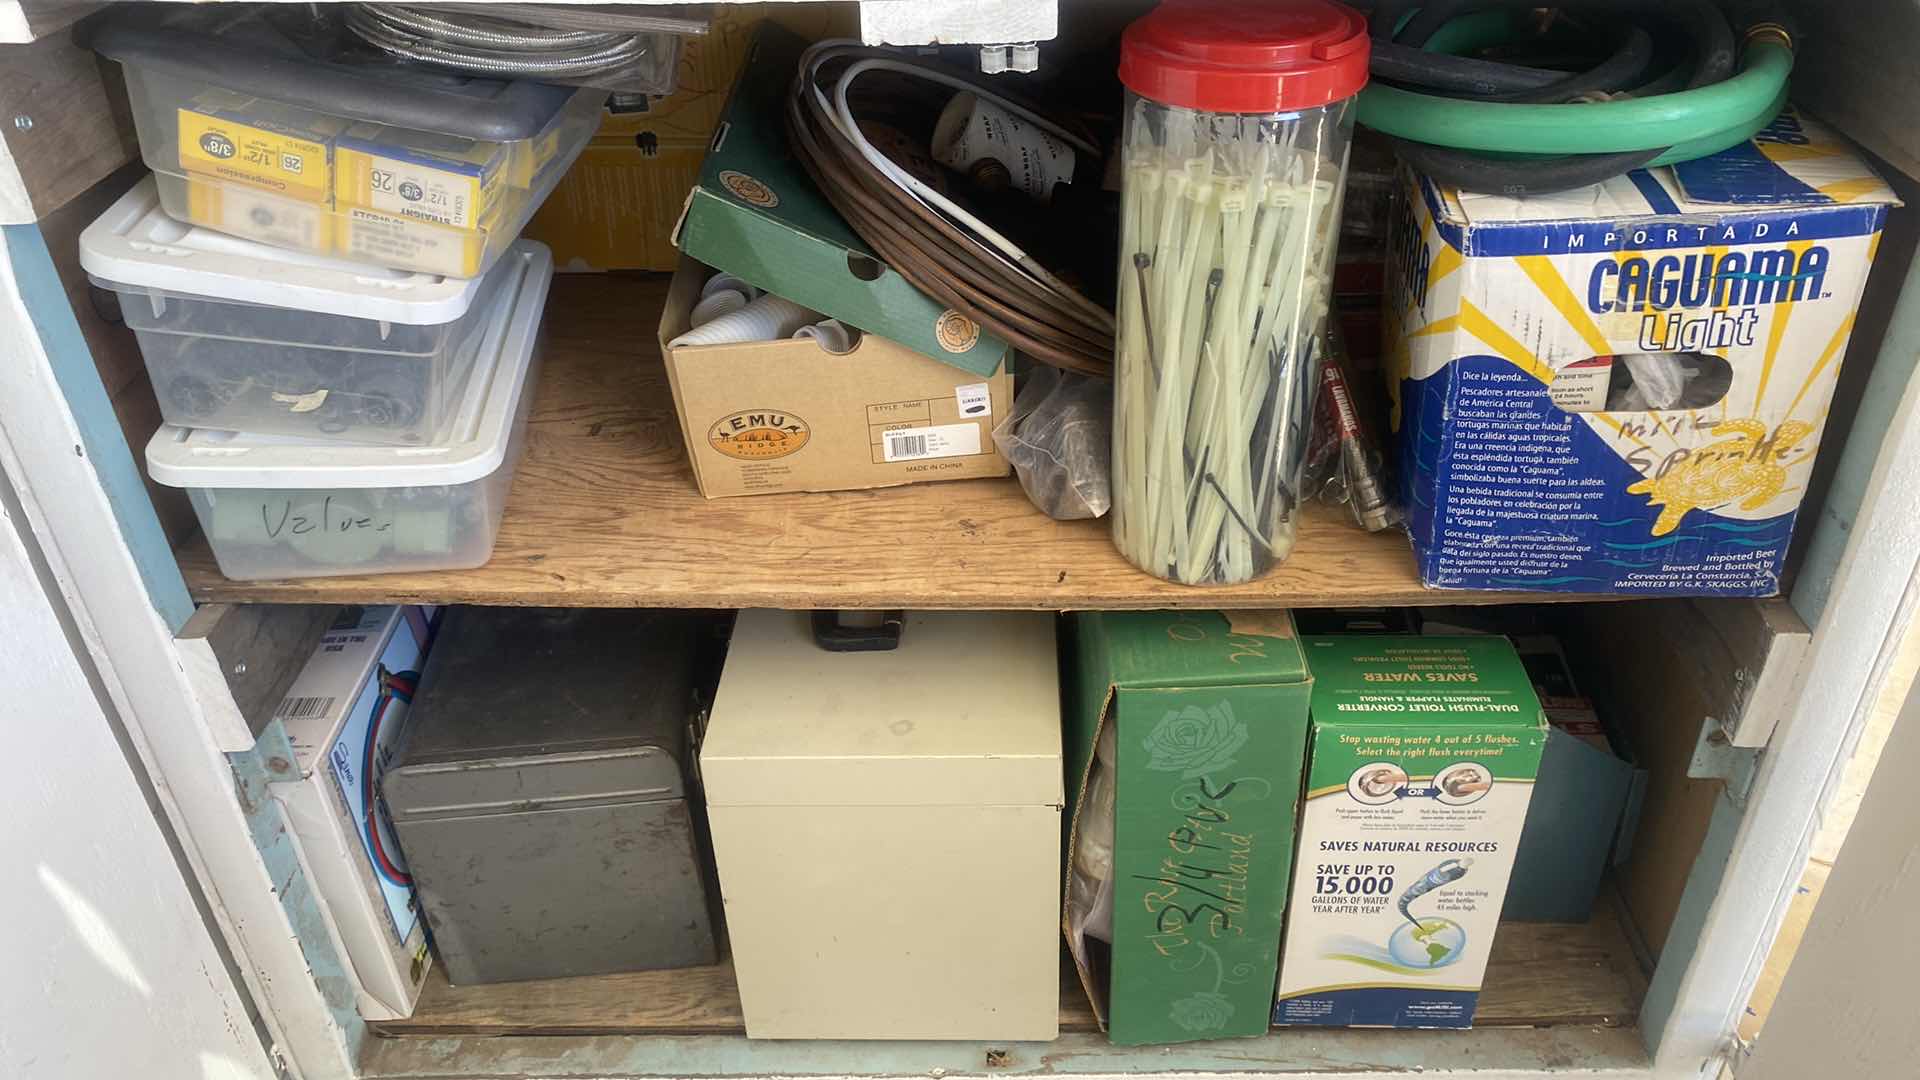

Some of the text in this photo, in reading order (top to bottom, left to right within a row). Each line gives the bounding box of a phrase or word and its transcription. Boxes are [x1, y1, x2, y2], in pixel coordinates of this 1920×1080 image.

[204, 140, 232, 156] 3/8"
[284, 156, 300, 170] 26
[216, 166, 286, 191] Compression
[371, 171, 392, 191] 26
[1588, 246, 1830, 315] CAGUAMA
[1638, 308, 1759, 353] Light
[1463, 371, 1480, 380] Dice
[1482, 372, 1489, 380] la
[1461, 387, 1504, 397] Pescadores
[1460, 398, 1533, 408] de América Central
[1459, 410, 1495, 418] buscaban
[1510, 412, 1540, 422] grandes
[730, 415, 785, 430] EMU
[1457, 420, 1540, 432] tortugas marinas que
[1467, 431, 1478, 439] las
[1480, 432, 1506, 441] cálidas
[1508, 435, 1530, 443] aguas
[1455, 442, 1466, 450] Era
[1556, 447, 1571, 455] que
[1452, 462, 1485, 472] conocida
[1510, 464, 1517, 473] la
[1450, 472, 1495, 482] simbolizaba
[1498, 475, 1521, 484] buena
[1523, 477, 1547, 485] suerte
[1450, 485, 1464, 493] Una
[1466, 486, 1491, 495] bebida
[1494, 489, 1533, 498] tradicional
[1448, 495, 1459, 503] los
[1460, 497, 1501, 507] pobladores
[1515, 500, 1557, 509] celebración
[1560, 503, 1572, 511] por
[1447, 506, 1474, 515] llegada
[1475, 508, 1485, 516] de
[1487, 508, 1495, 516] la
[1496, 510, 1538, 519] majestuosa
[1540, 512, 1569, 520] criatura
[1535, 543, 1575, 551] tradicional
[1460, 549, 1470, 557] del
[1473, 550, 1490, 558] siglo
[1706, 550, 1776, 562] Imported Beer
[1455, 558, 1497, 567] igualmente
[1520, 559, 1548, 568] disfrute
[1702, 563, 1721, 571] and
[1724, 561, 1761, 571] Bottled
[1763, 561, 1774, 569] by
[1681, 572, 1693, 580] La
[1364, 672, 1479, 683] SAVES WATER
[1442, 695, 1492, 703] ELIMINATES
[1337, 703, 1519, 713] DUAL-FLUSH TOILET CONVERTER
[1339, 735, 1361, 745] Stop
[1364, 735, 1401, 746] wasting
[1404, 736, 1432, 745] water
[1434, 735, 1441, 744] 4
[1444, 736, 1460, 744] out
[1462, 735, 1473, 744] of
[1476, 735, 1482, 744] 5
[1356, 747, 1504, 758] Select the right flush everytime!
[1408, 788, 1425, 796] OR
[1320, 841, 1498, 852] SAVES NATURAL RESOURCES
[1317, 864, 1395, 875] SAVE UP TO
[1315, 876, 1394, 896] 15,000
[1311, 896, 1349, 904] GALLONS
[1350, 896, 1362, 904] OF
[1312, 905, 1333, 913] YEAR
[1335, 905, 1359, 913] AFTER
